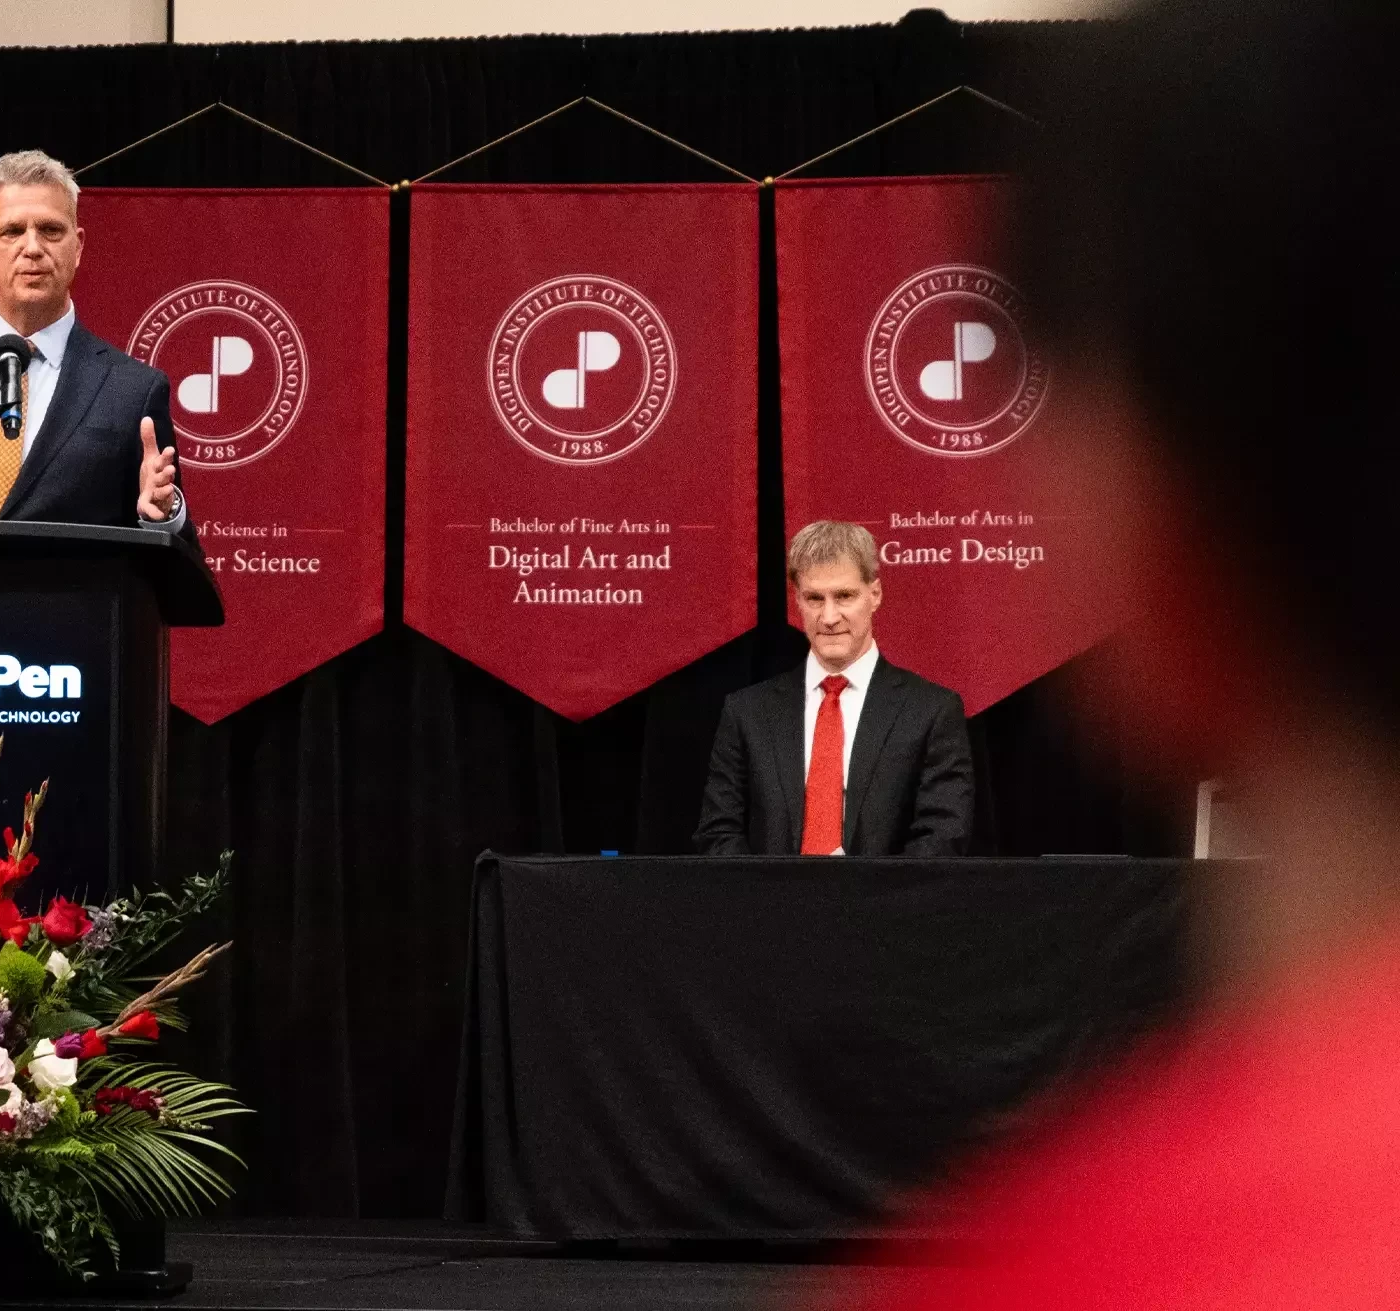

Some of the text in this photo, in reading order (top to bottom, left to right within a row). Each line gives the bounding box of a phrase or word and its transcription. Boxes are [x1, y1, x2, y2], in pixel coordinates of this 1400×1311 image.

[878, 274, 968, 340] INSTITUTE
[138, 289, 299, 438] INSTITUTE OF TECHNOLOGY
[497, 284, 667, 435] DIGIPEN INSTITUTE OF TECHNOLOGY
[873, 347, 911, 427] DIGIPEN
[212, 520, 268, 537] Science
[273, 522, 288, 537] in
[489, 517, 671, 533] Bachelor of Fine Arts in
[890, 509, 1034, 528] Bachelor of Arts in
[233, 548, 321, 573] Science
[488, 544, 672, 576] Digital Art and
[880, 538, 1045, 570] Game Design
[513, 580, 643, 604] Animation
